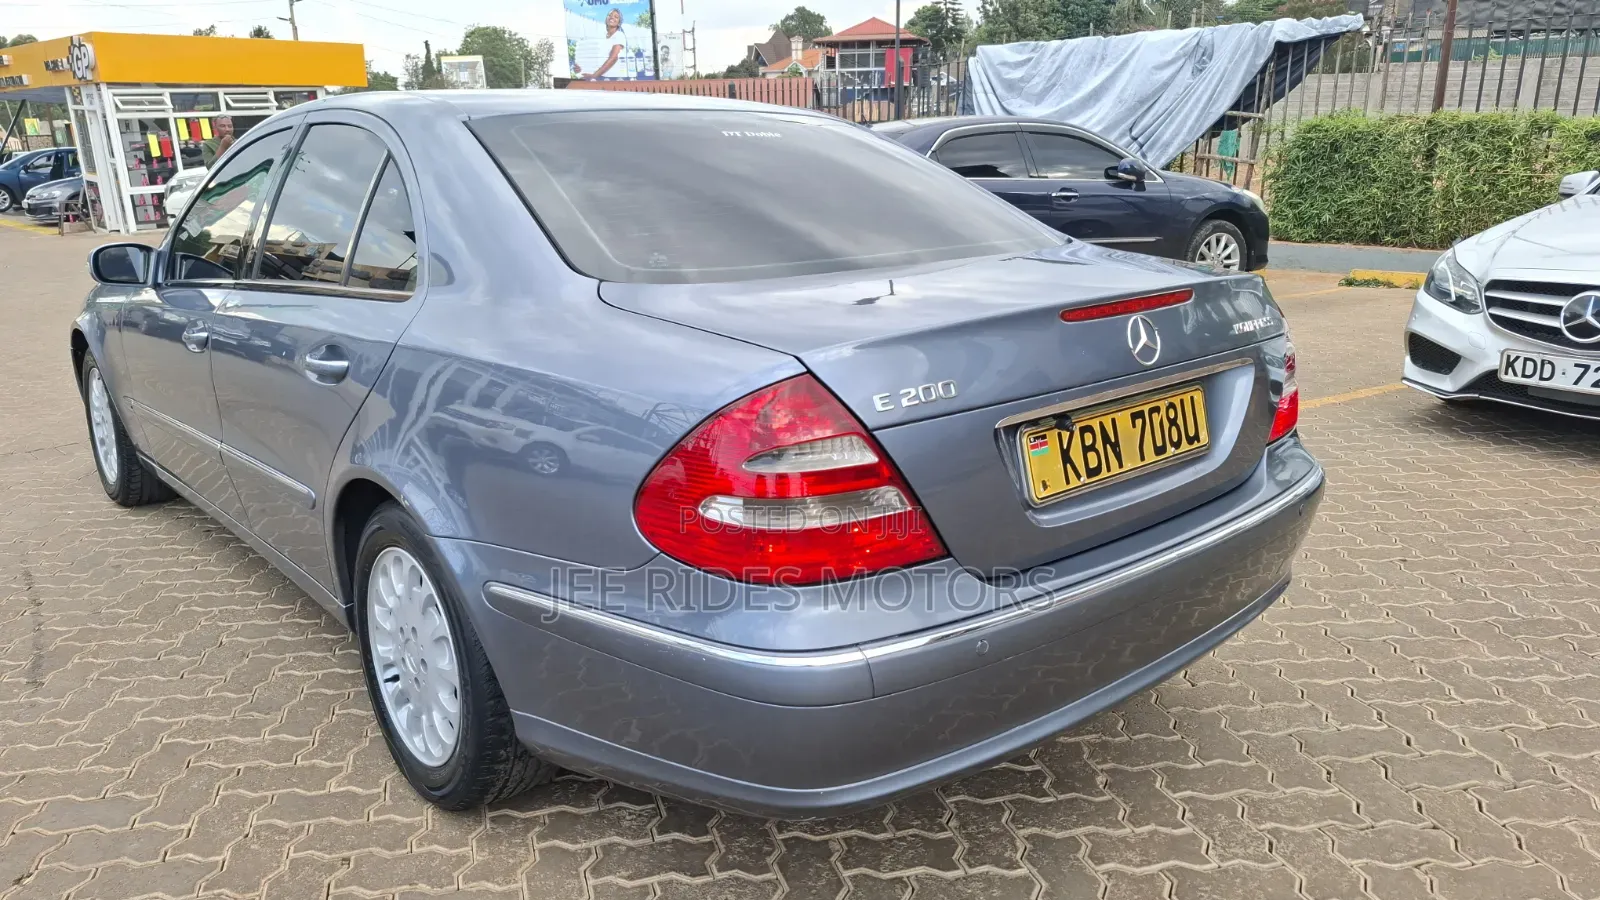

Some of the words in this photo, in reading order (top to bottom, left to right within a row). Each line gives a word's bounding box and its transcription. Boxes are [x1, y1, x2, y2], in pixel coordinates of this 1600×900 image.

[1504, 354, 1556, 382] KDD
[872, 392, 895, 412] E
[900, 379, 957, 408] 200
[1057, 417, 1124, 486] KBN
[1130, 395, 1201, 462] 708U
